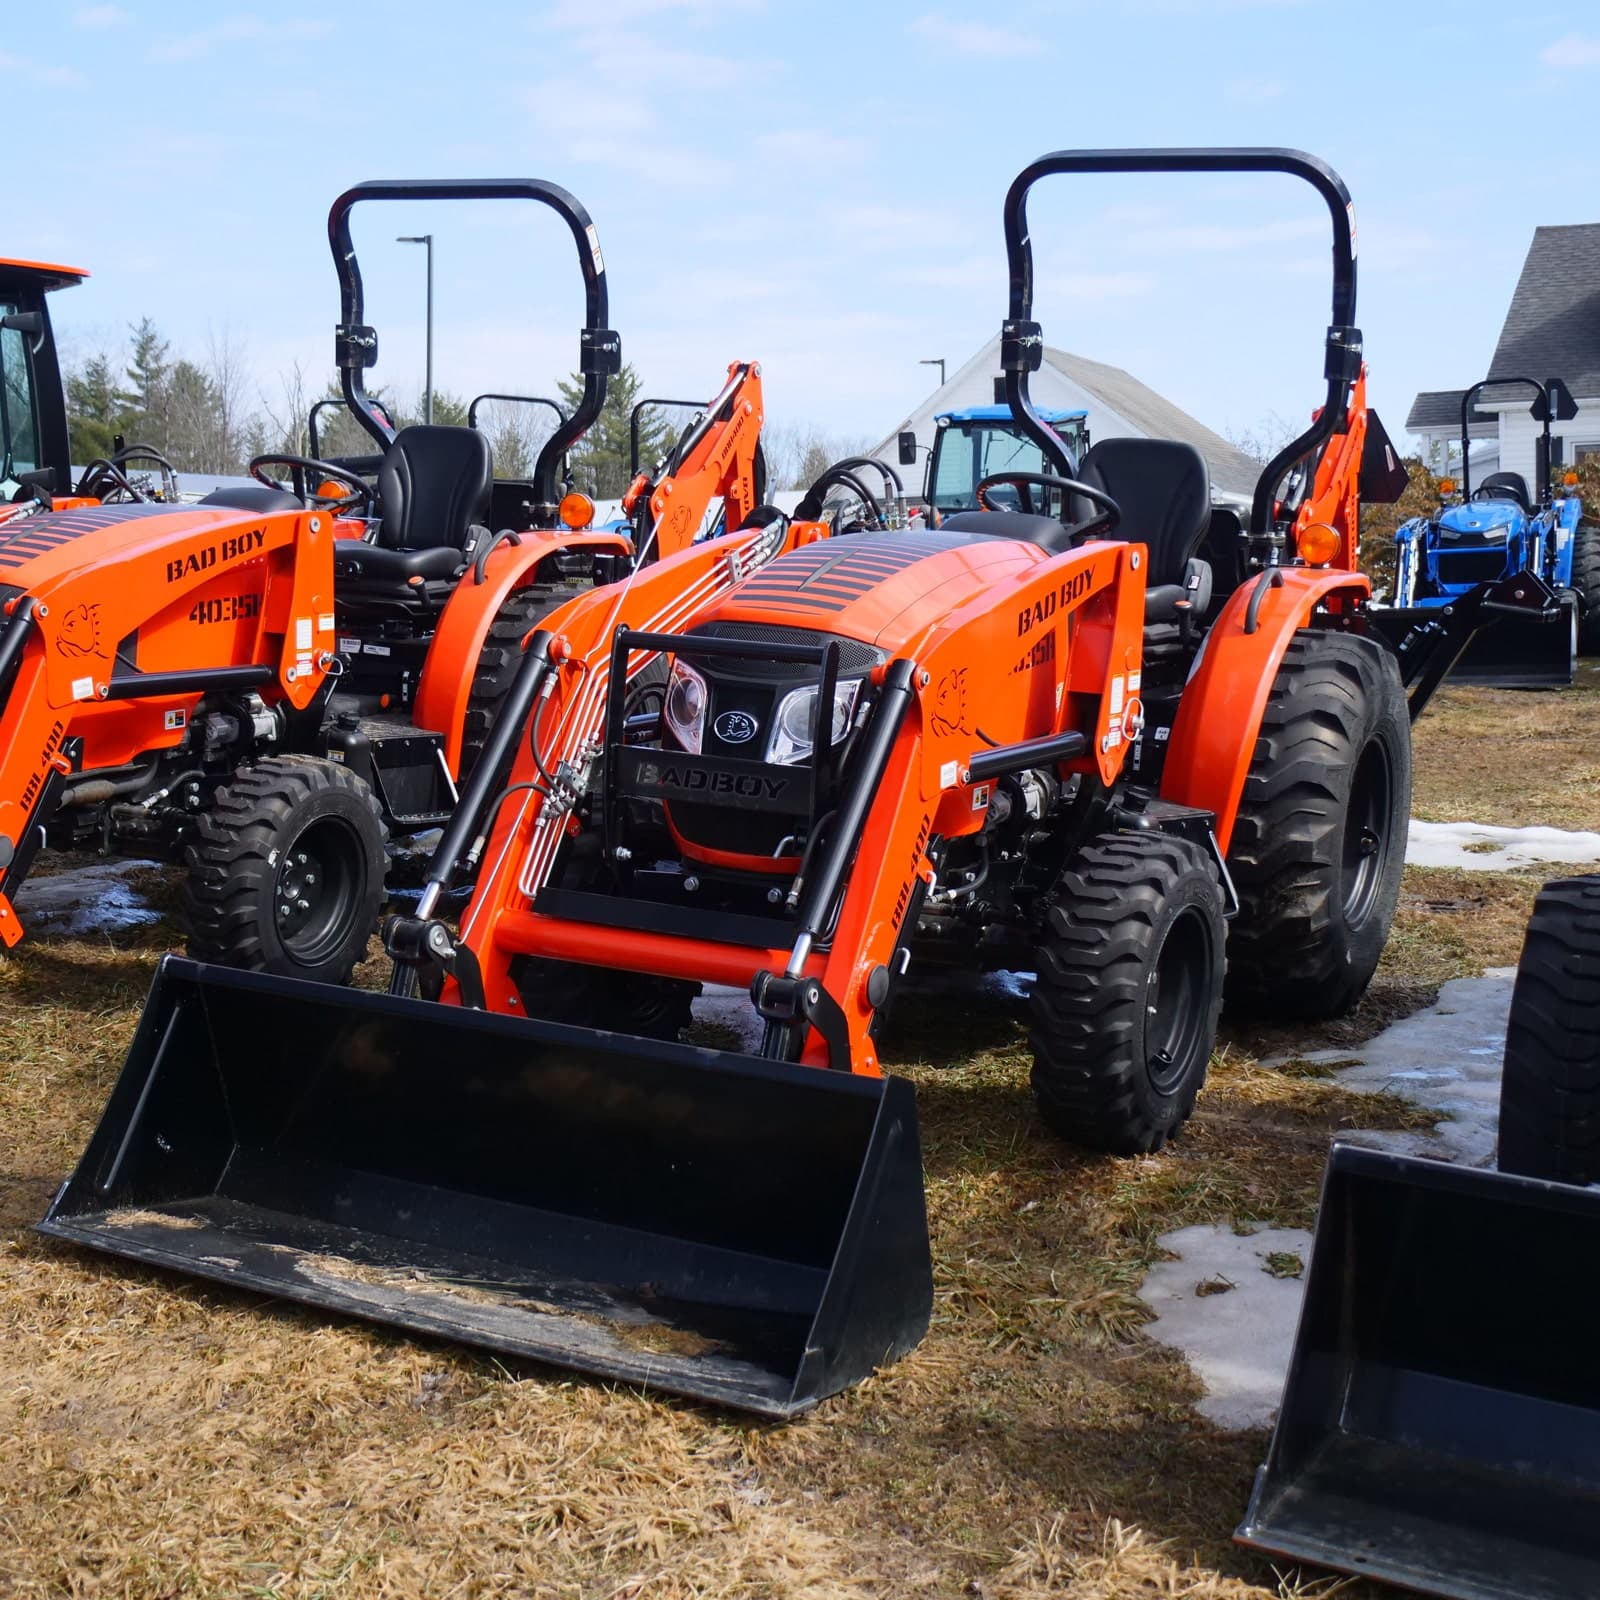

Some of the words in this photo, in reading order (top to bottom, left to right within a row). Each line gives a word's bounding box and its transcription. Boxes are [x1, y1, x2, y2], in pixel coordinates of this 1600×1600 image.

[167, 546, 216, 583] BAD
[222, 525, 267, 561] BOY
[1017, 590, 1056, 637] BAD
[1060, 563, 1096, 608] BOY
[20, 771, 44, 812] BBL
[41, 720, 64, 768] 400
[891, 881, 912, 931] BBL
[911, 813, 930, 873] 400
